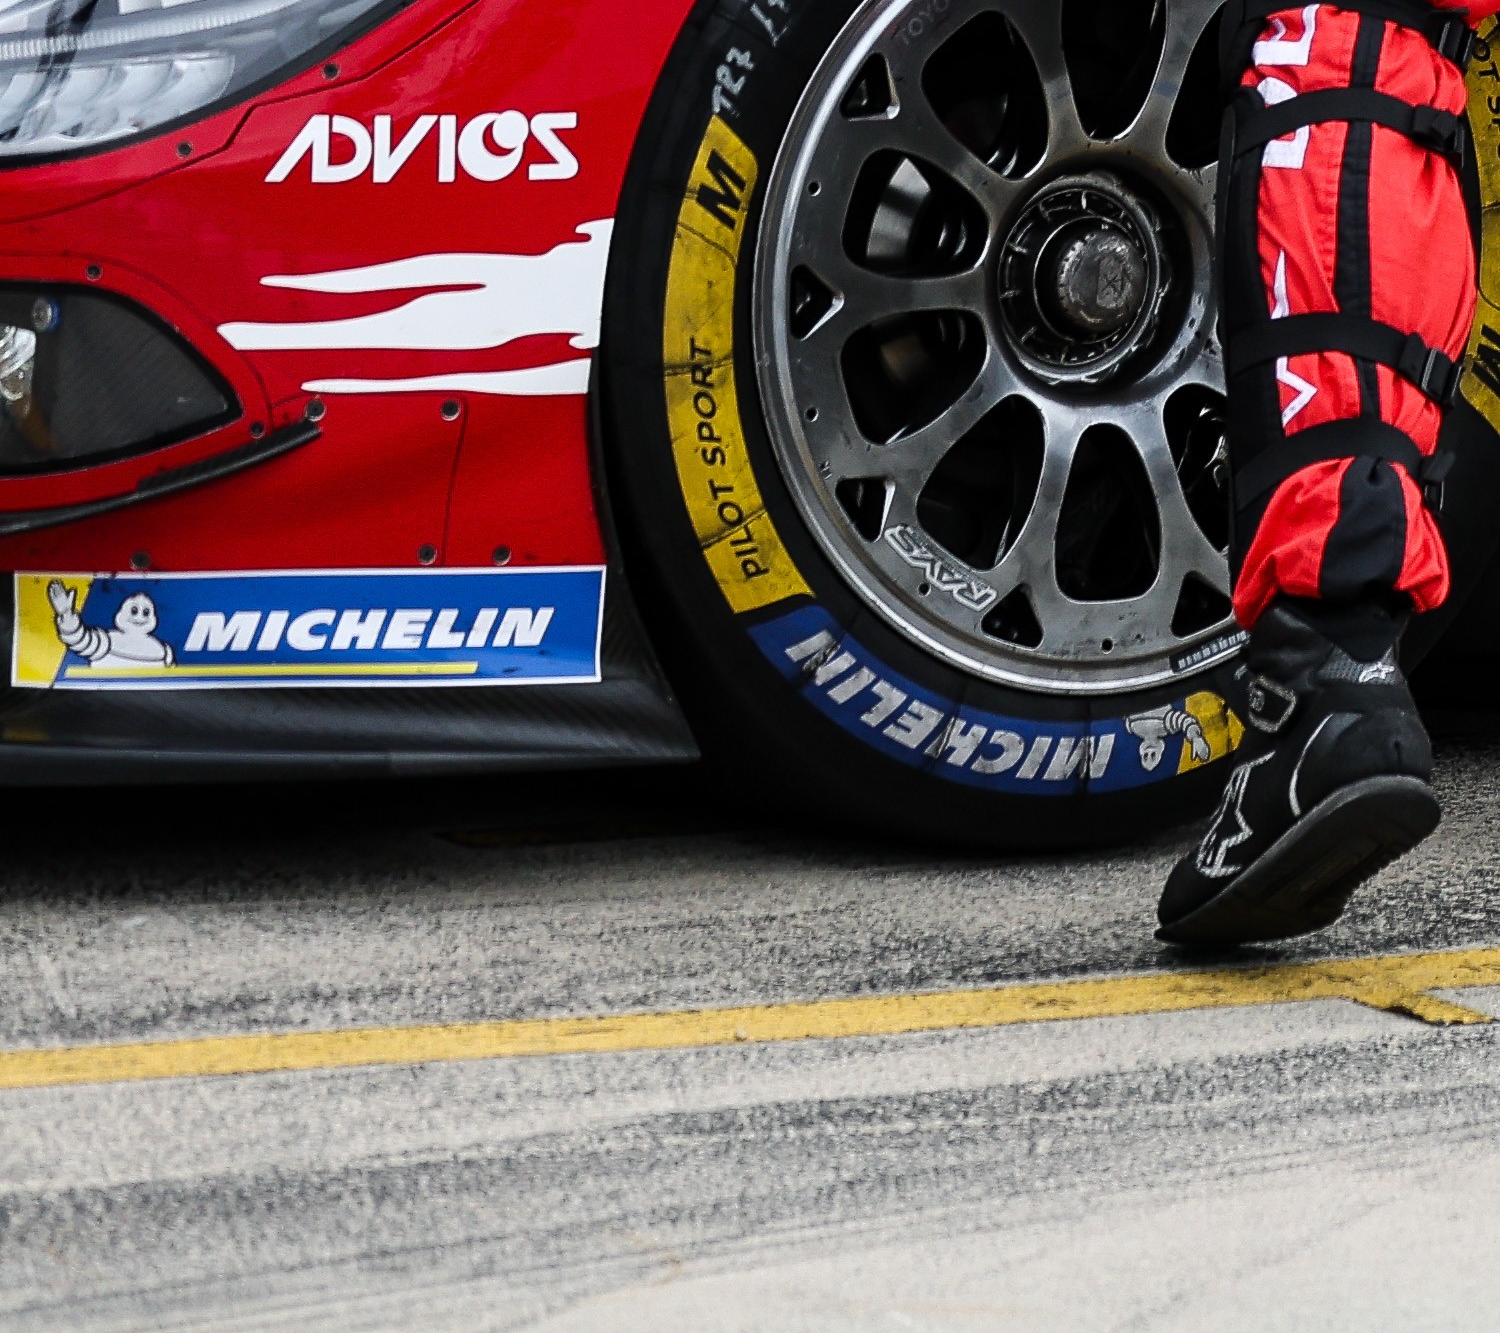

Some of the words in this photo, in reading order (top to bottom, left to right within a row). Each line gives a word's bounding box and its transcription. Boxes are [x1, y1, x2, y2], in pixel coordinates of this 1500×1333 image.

[265, 111, 579, 185] ADVICS
[697, 150, 746, 232] M
[699, 337, 732, 466] SPORT
[712, 481, 766, 580] PILOT
[186, 606, 555, 653] MICHELIN
[783, 627, 1115, 783] MICHELIN
